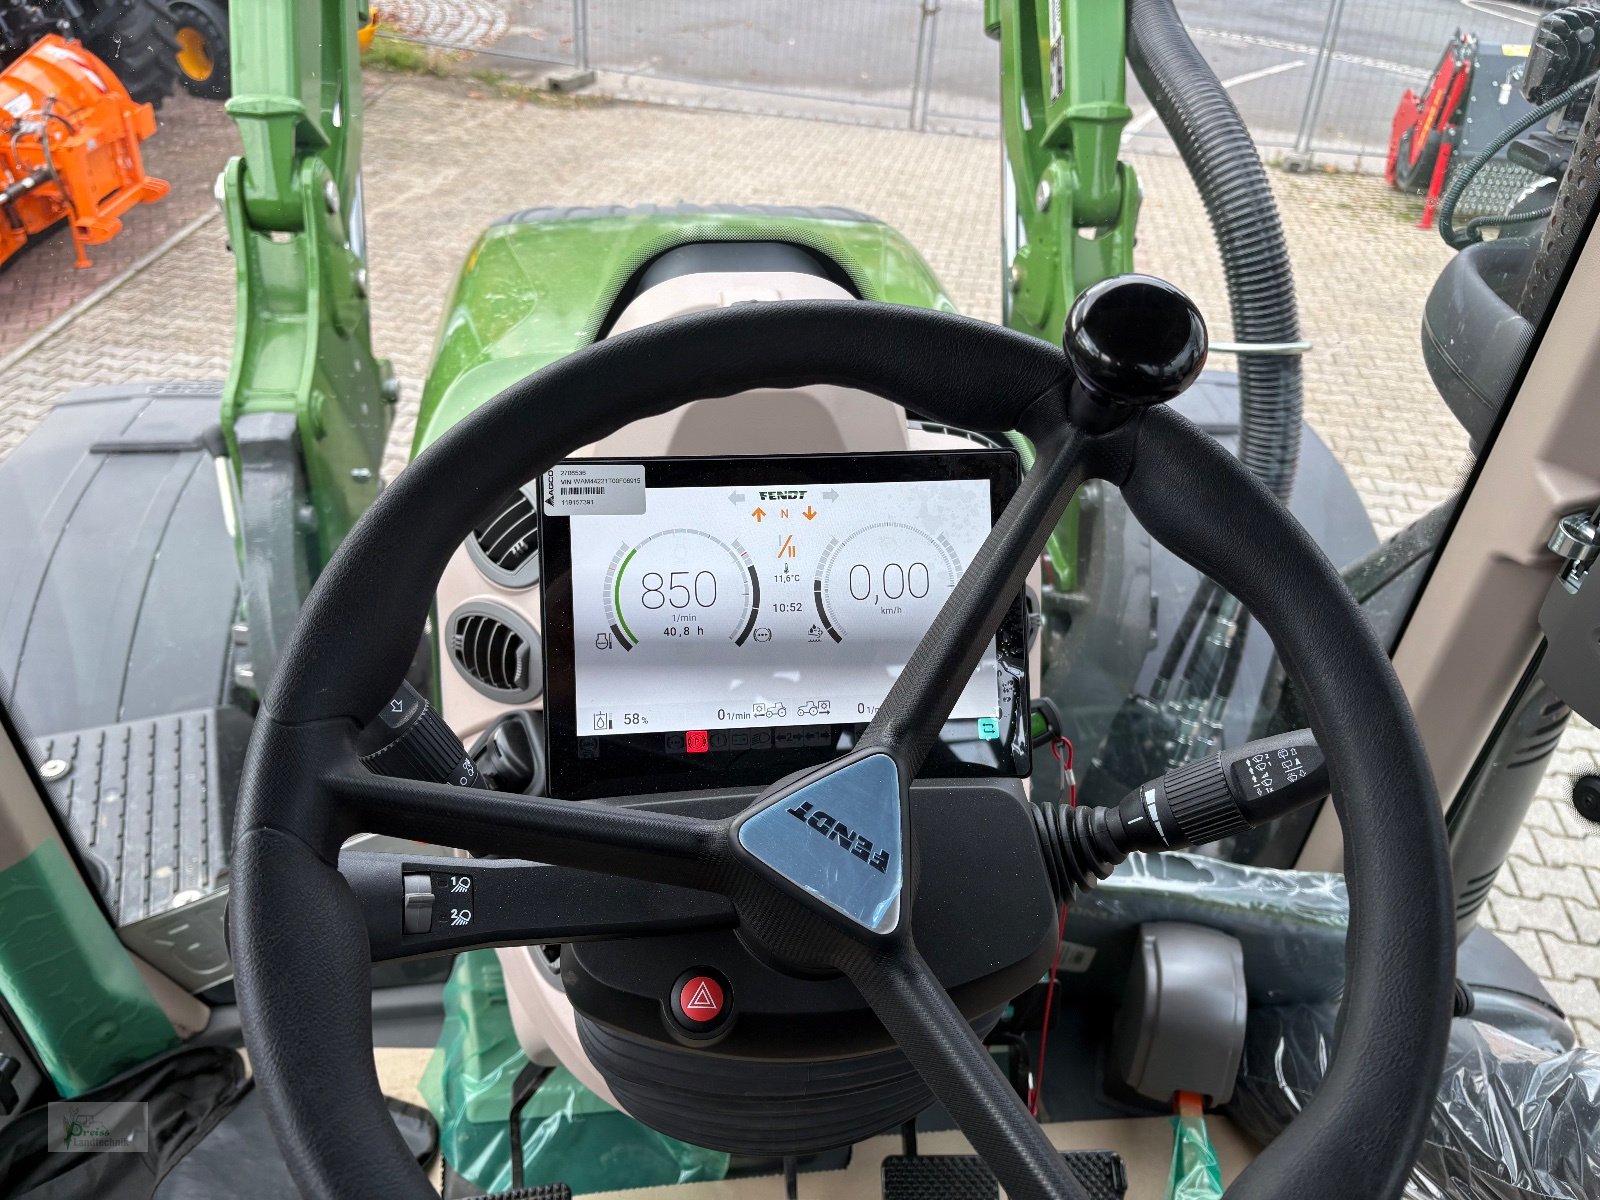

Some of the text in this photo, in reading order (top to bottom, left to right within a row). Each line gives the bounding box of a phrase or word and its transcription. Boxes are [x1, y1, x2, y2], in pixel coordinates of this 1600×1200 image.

[759, 490, 808, 500] FENDT
[781, 509, 789, 519] N
[774, 574, 800, 583] 11,6°C
[849, 562, 930, 606] 0,00
[641, 570, 717, 610] 850
[772, 602, 803, 613] 10:52
[880, 606, 902, 615] km/h
[672, 613, 697, 622] 1/min
[663, 626, 704, 637] 40,8 h
[857, 702, 865, 714] 0
[624, 713, 640, 725] 58
[717, 708, 751, 721] 0 1/min
[786, 801, 891, 875] FENDT
[450, 876, 457, 886] 1
[450, 908, 458, 919] 2
